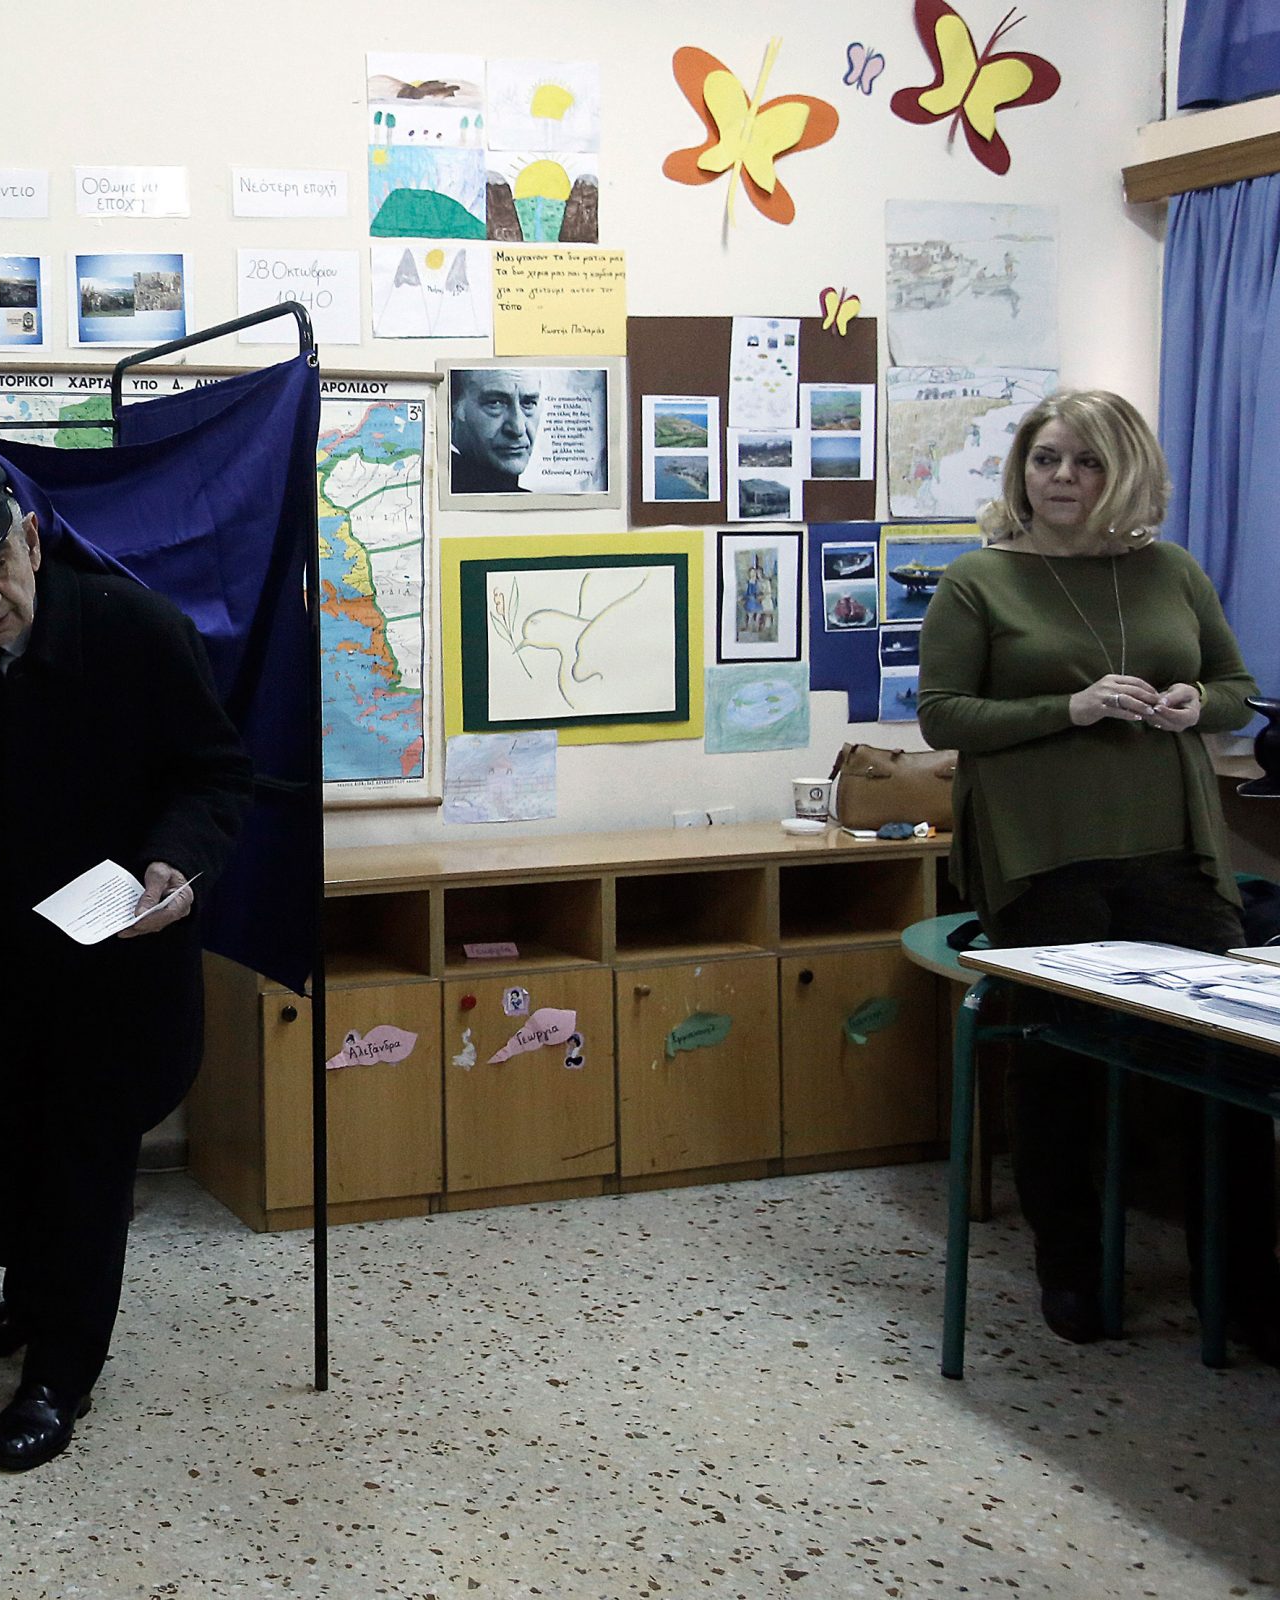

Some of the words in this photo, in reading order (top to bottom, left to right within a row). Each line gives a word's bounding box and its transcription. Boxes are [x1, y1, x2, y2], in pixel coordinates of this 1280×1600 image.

[240, 177, 299, 197] Νεότερη
[304, 180, 337, 197] εποχή
[246, 259, 269, 279] 28
[68, 377, 112, 389] ΧΑΡΤΑ
[132, 380, 158, 390] ΥΠΟ
[172, 378, 184, 390] Δ.
[321, 382, 388, 394] ΑΡΟΛΙΔΟΥ
[349, 1040, 401, 1059] Αλεξάνδρα
